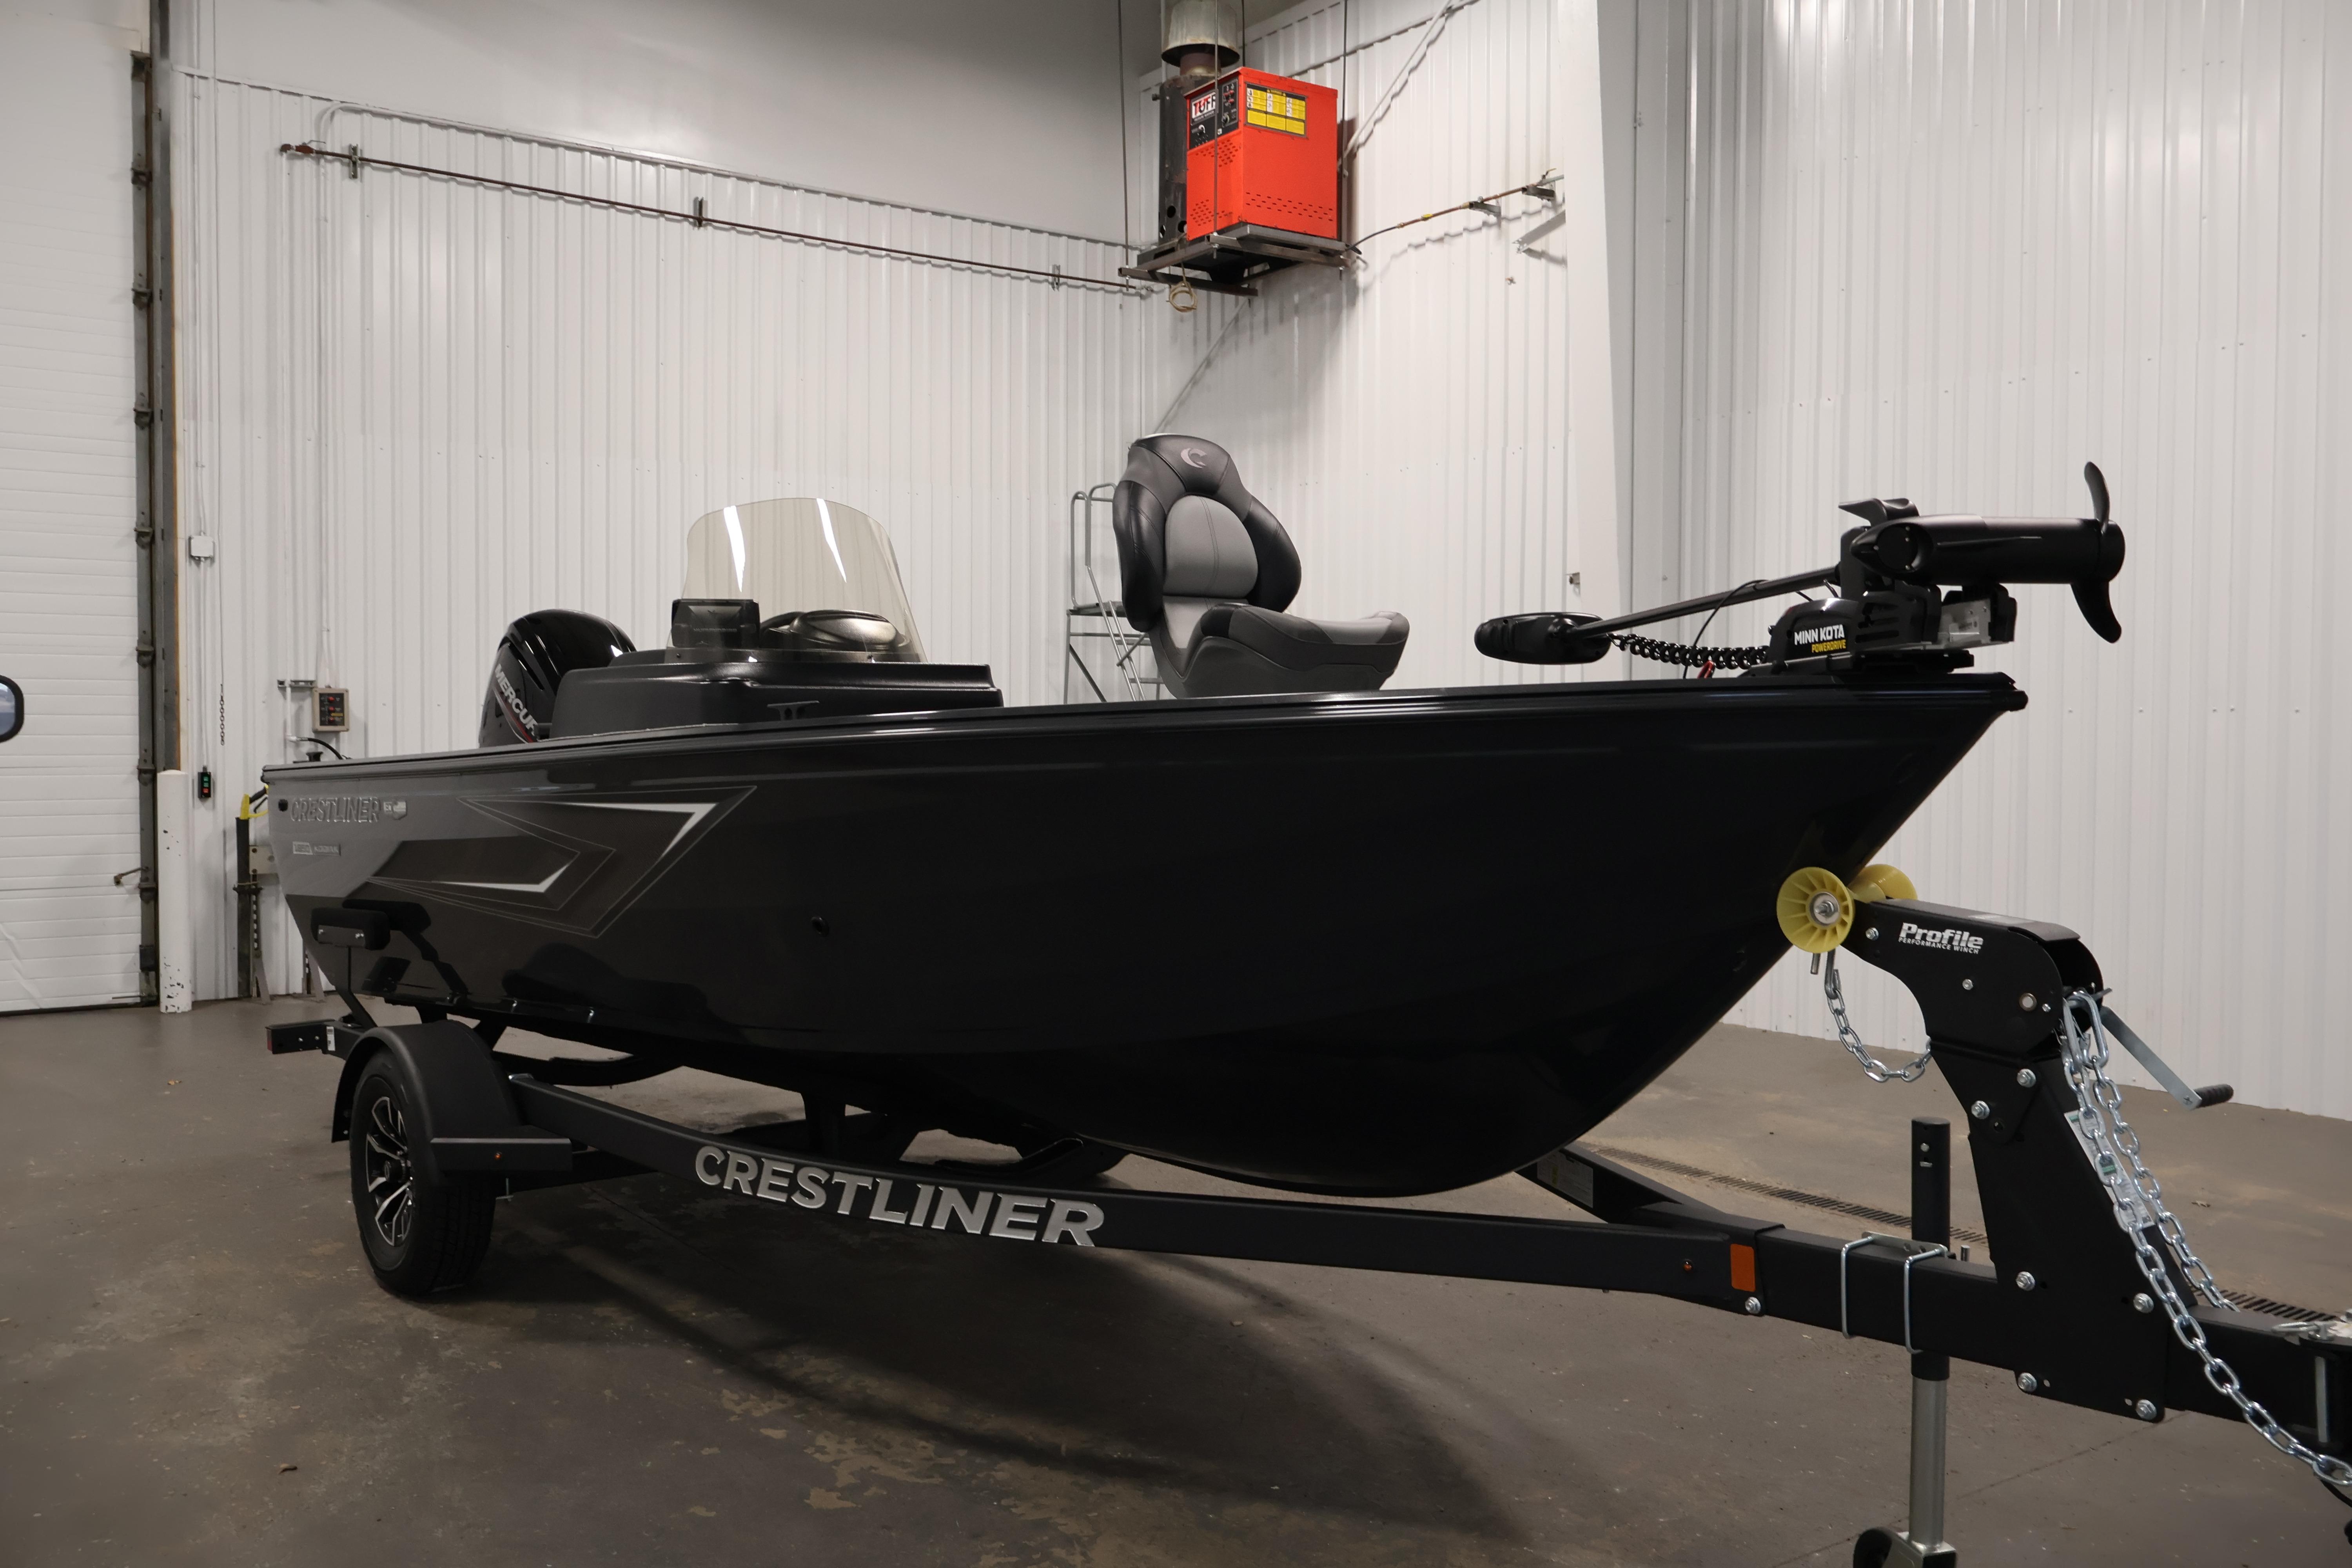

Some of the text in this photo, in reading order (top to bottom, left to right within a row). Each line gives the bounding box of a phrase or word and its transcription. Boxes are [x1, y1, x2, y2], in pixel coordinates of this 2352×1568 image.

[1794, 624, 1845, 645] MINN KOTA
[1811, 639, 1846, 653] POWERDRIVE
[495, 663, 539, 737] MERCUR
[290, 797, 381, 823] CRESTLINER
[1898, 936, 1979, 954] PERFORMANCE WINCH
[1900, 922, 1984, 949] Profile
[695, 1145, 1105, 1247] CRESTLINER
